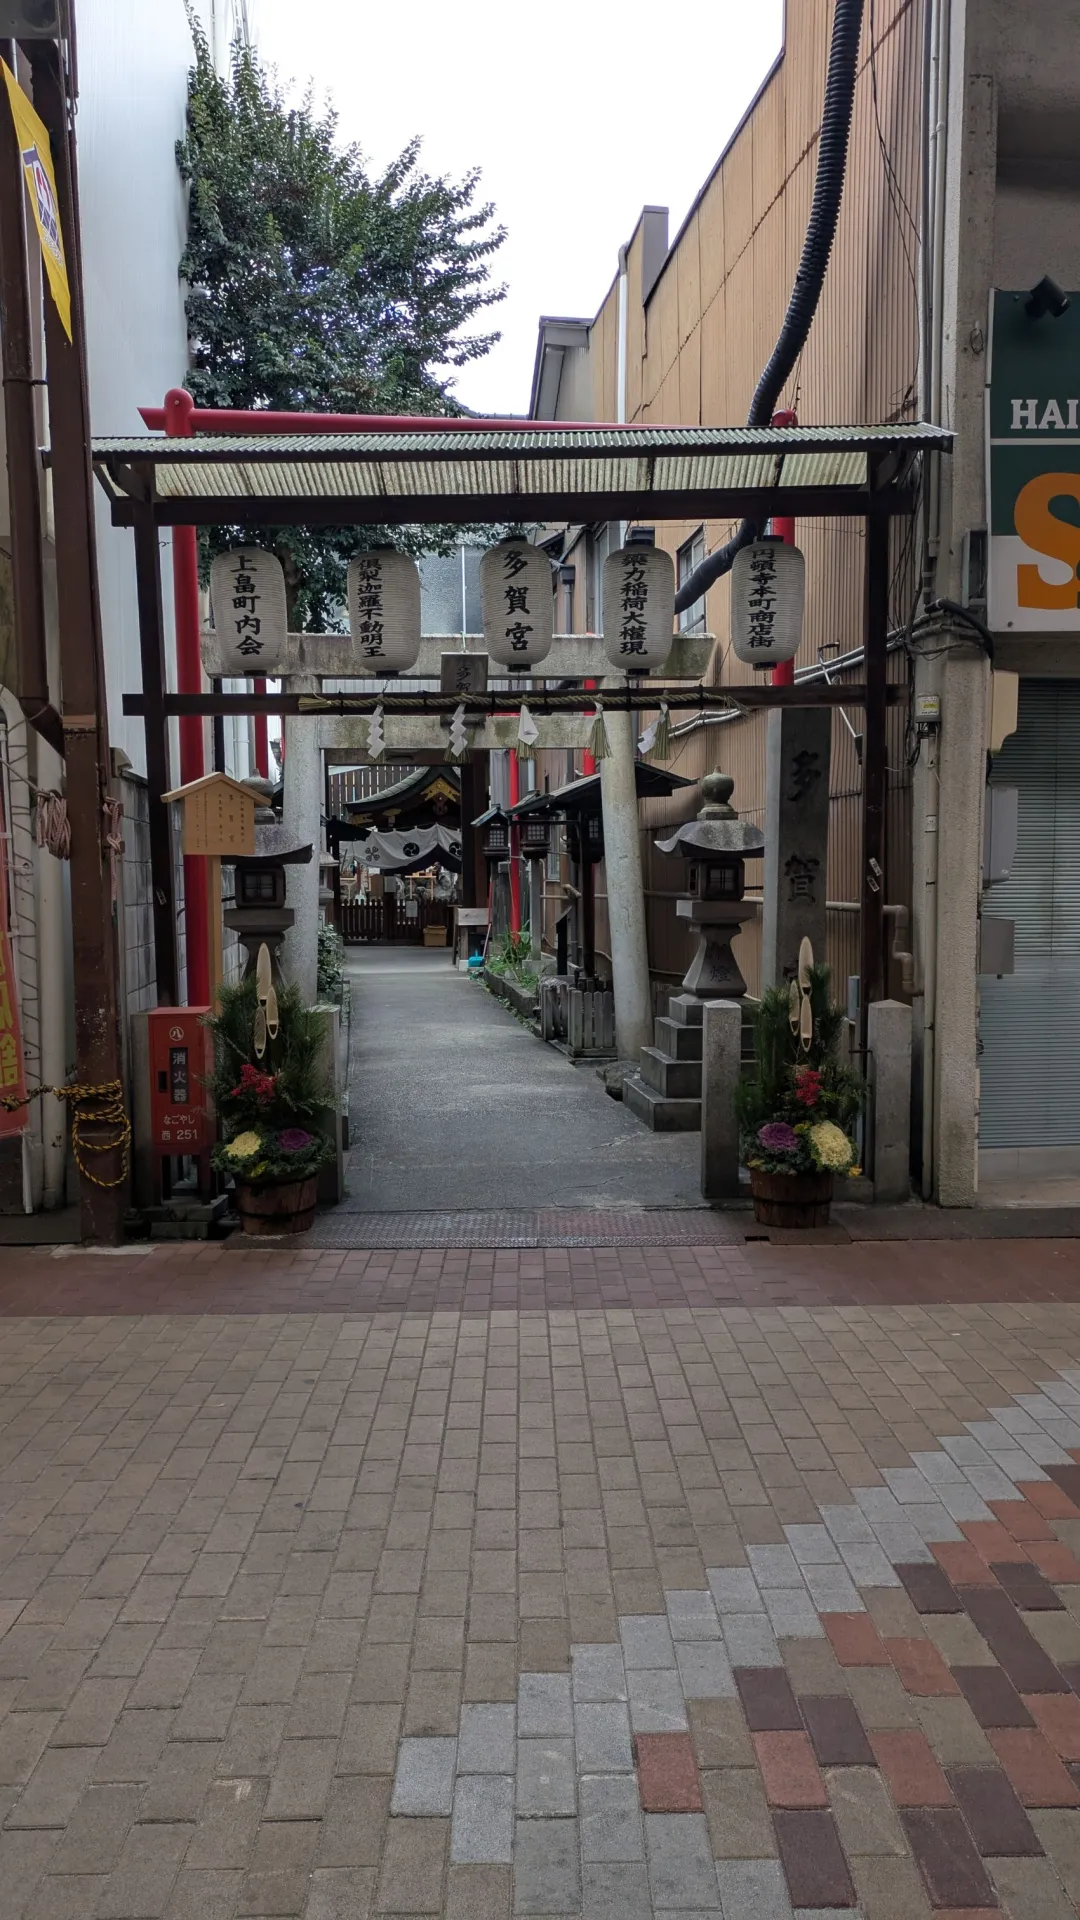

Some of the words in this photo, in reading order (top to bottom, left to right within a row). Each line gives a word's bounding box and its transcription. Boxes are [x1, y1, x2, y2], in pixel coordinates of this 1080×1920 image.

[1011, 399, 1078, 430] HAI
[231, 555, 265, 656] 上畠町内会
[503, 550, 534, 651] 多賀宮
[747, 547, 777, 648] 円頓寺本町商店街
[172, 1052, 187, 1102] 消火器
[163, 1114, 195, 1125] なごやし
[176, 1129, 198, 1140] 251
